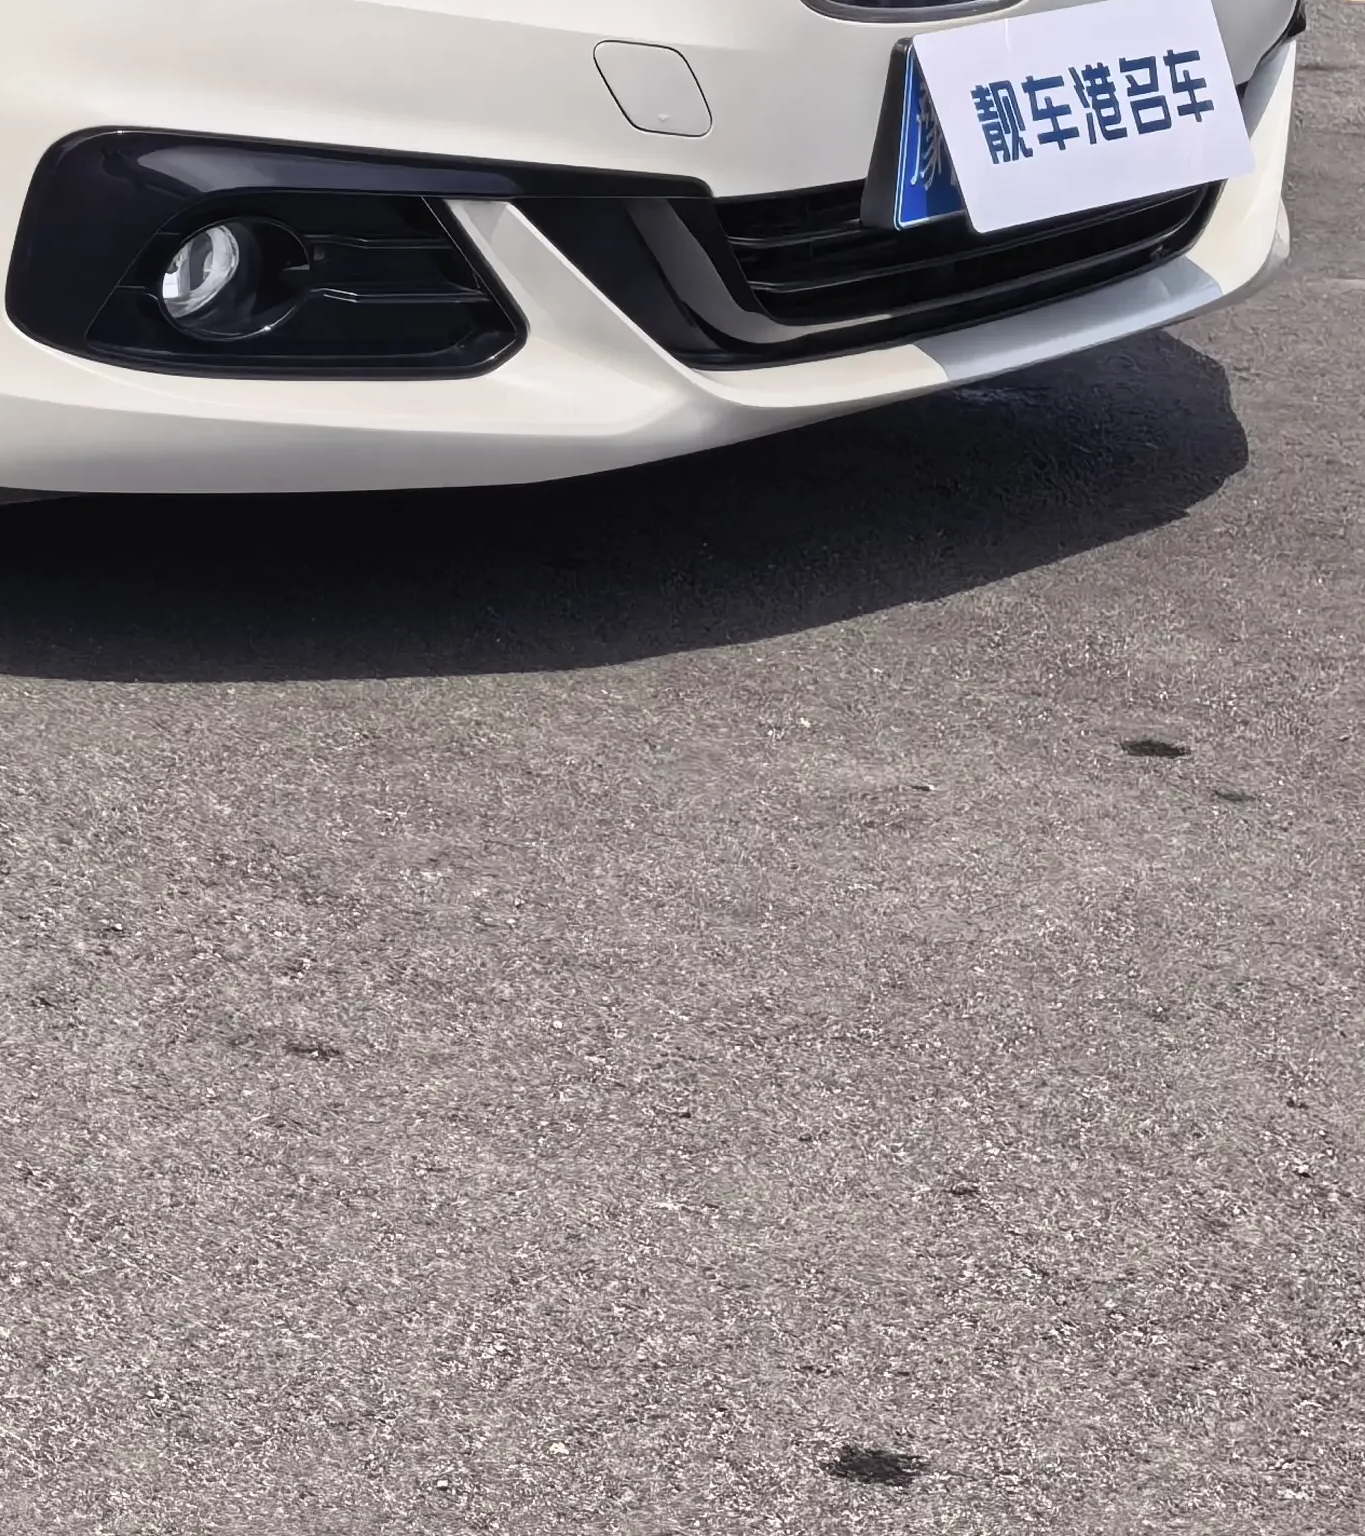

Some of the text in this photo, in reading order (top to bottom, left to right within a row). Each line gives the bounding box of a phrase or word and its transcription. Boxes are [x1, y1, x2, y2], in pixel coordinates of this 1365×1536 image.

[971, 49, 1215, 165] 靓车港名车
